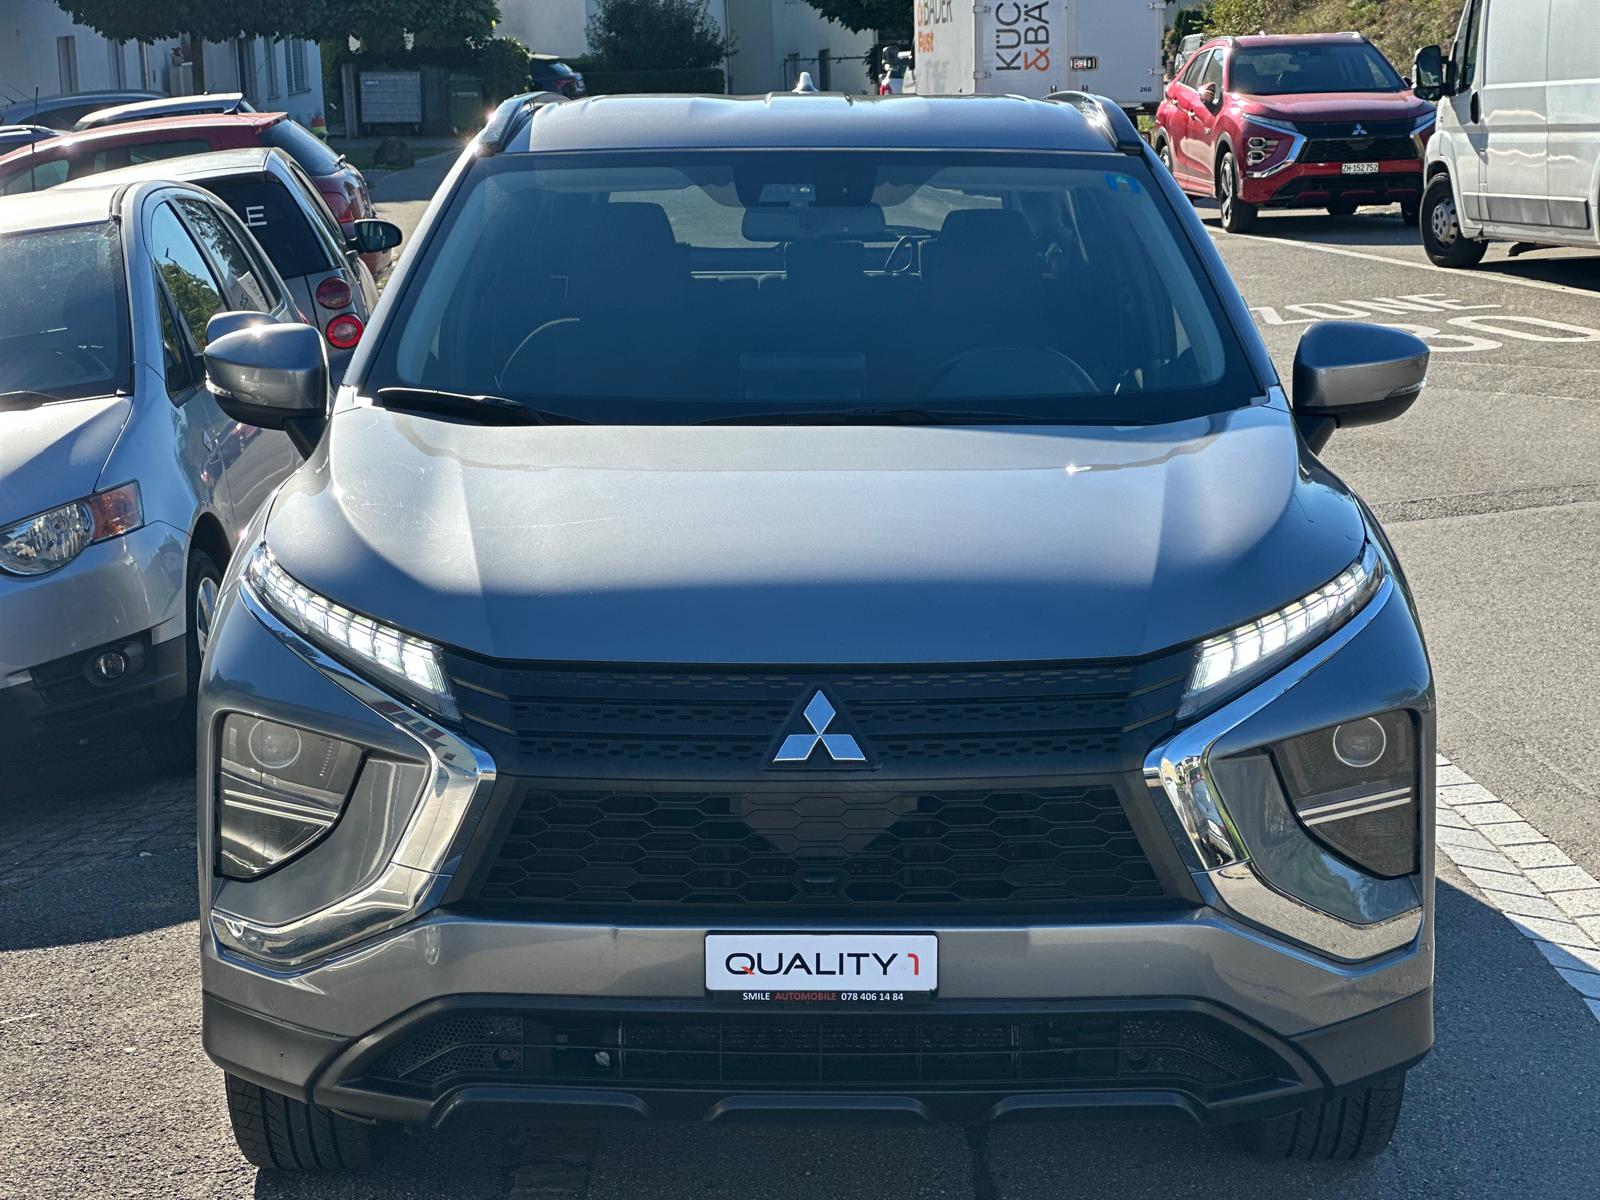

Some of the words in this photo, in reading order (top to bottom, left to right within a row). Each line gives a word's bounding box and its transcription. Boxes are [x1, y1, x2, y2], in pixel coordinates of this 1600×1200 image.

[996, 2, 1021, 70] KÜC
[245, 205, 267, 226] E
[1249, 293, 1502, 325] ZONE
[1377, 315, 1600, 352] 30
[725, 952, 899, 976] QUALITY
[907, 953, 920, 976] 1
[742, 992, 771, 1001] SMILE
[774, 992, 837, 1001] AUTOMOBILE
[841, 992, 858, 1001] 078
[860, 992, 877, 1001] 406
[879, 992, 890, 1001] 14
[892, 992, 904, 1001] 84
